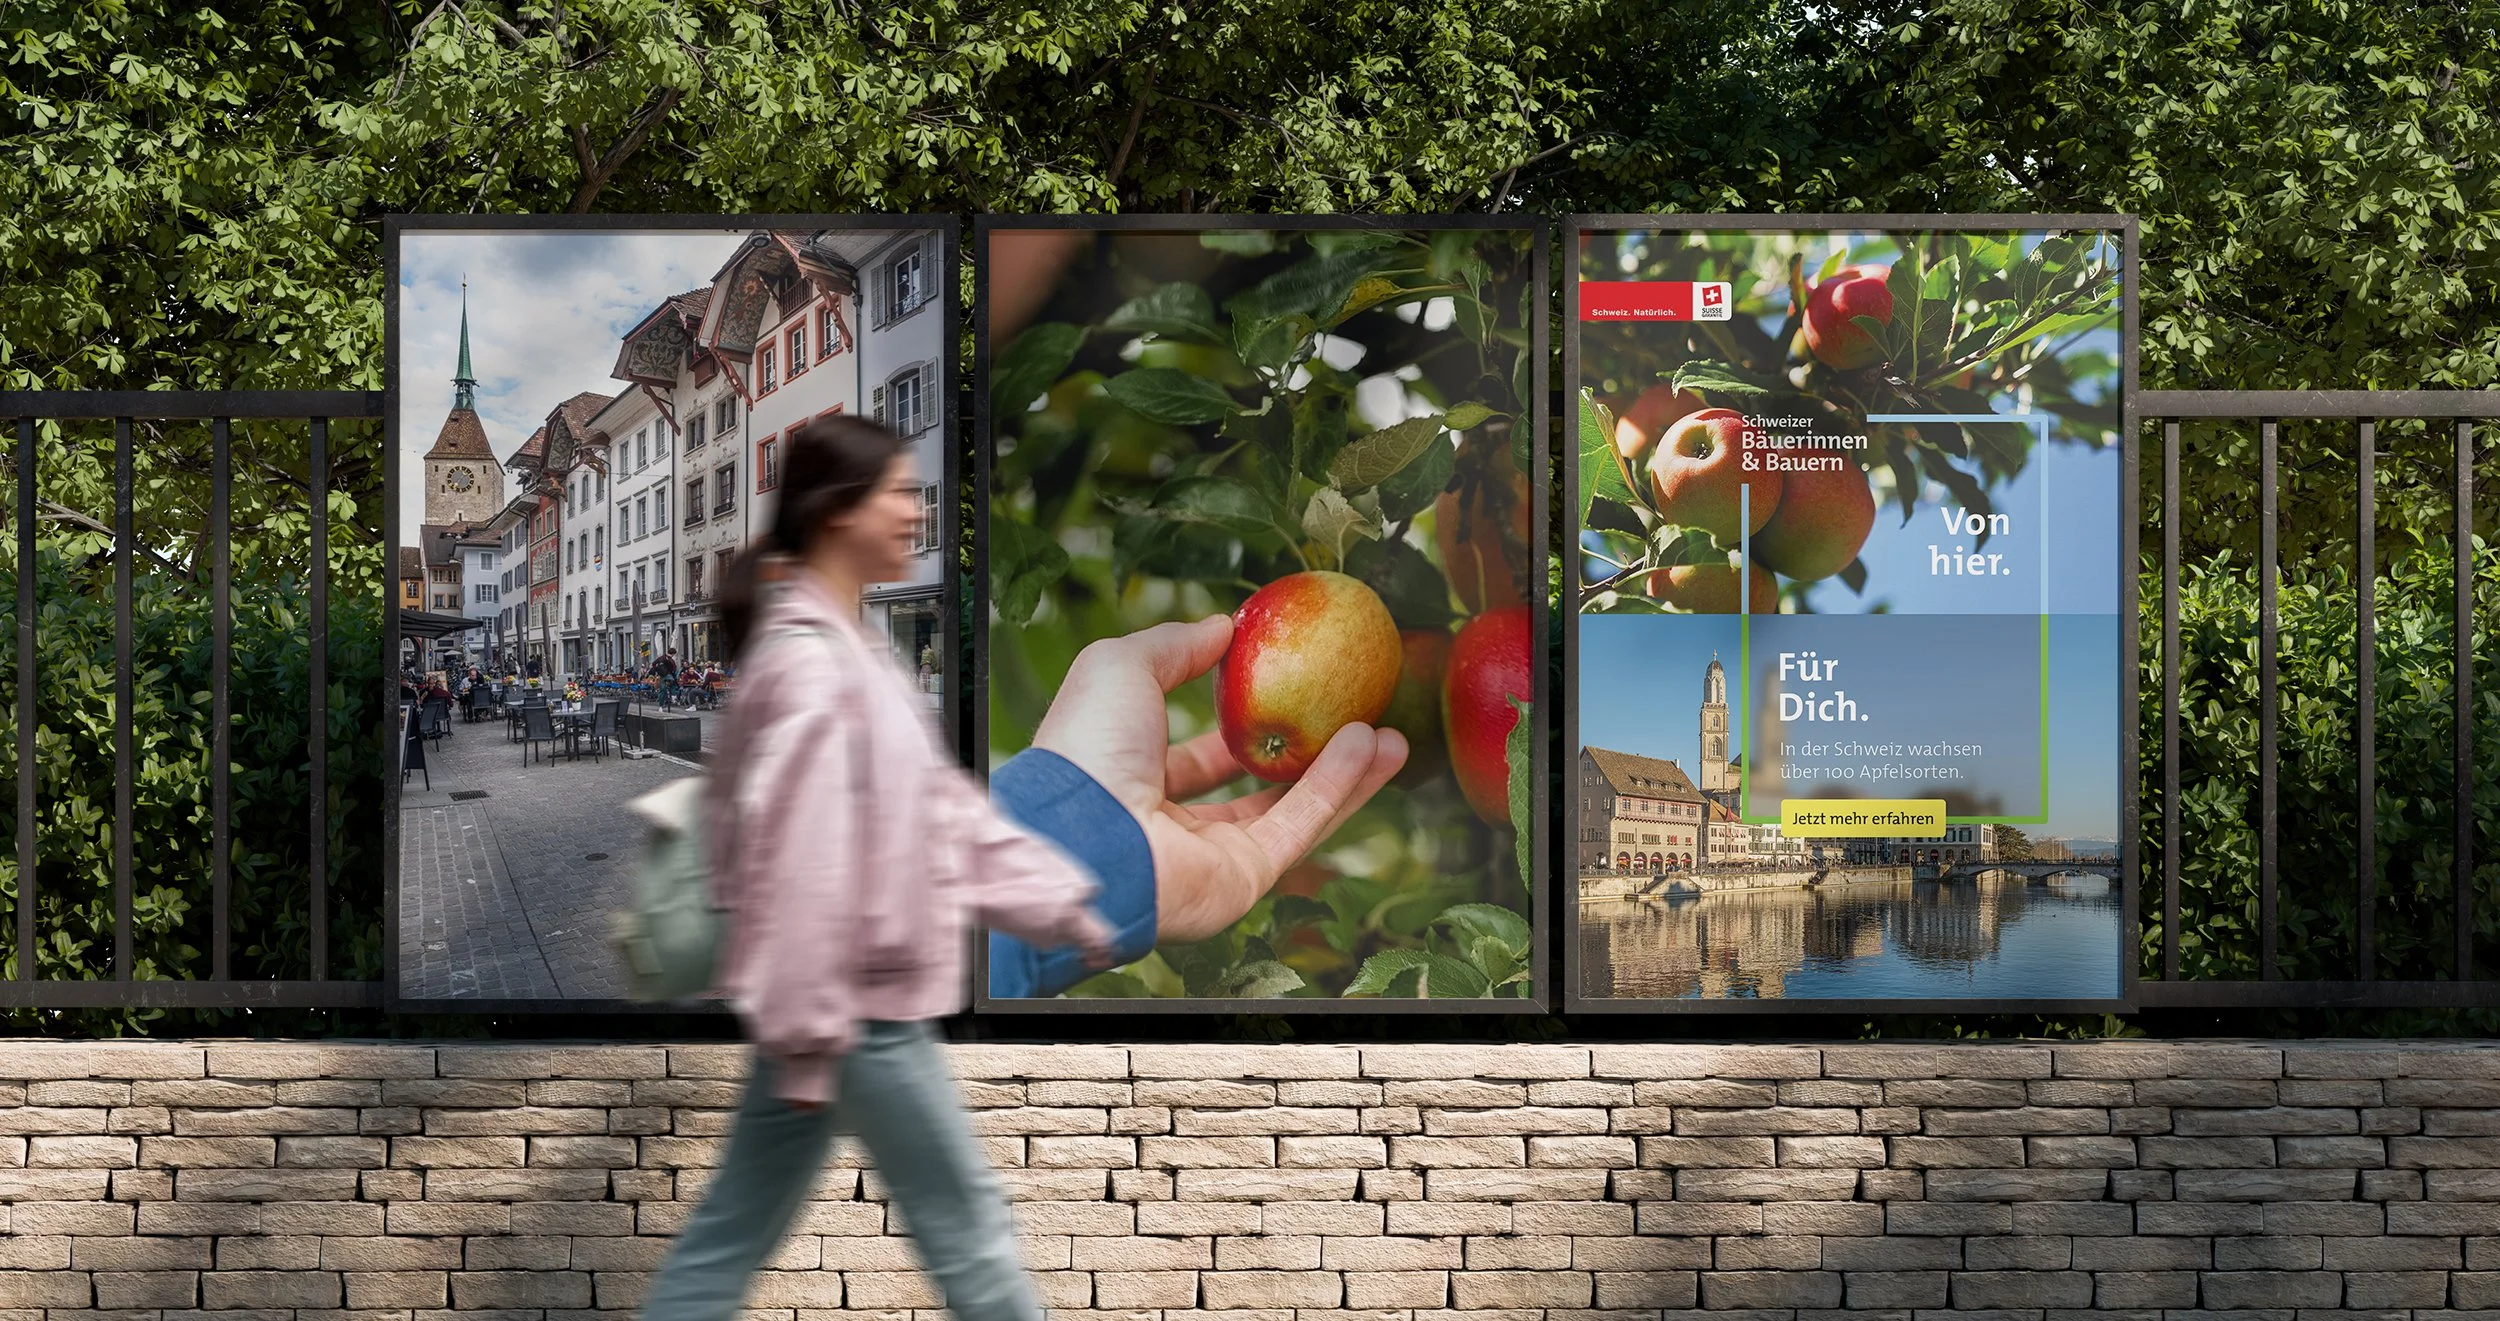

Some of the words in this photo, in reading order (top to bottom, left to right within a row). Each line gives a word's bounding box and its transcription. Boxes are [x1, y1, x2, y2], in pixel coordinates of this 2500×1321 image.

[1633, 308, 1676, 316] Natürlich.
[1741, 415, 1814, 427] Schweizer
[1741, 430, 1868, 449] Bäuerinnen
[1741, 452, 1760, 471] &
[1766, 453, 1843, 471] Bauern
[1941, 507, 2010, 536] Von
[1928, 545, 2011, 575] hier.
[1779, 651, 1839, 682] Für
[1779, 691, 1869, 722] Dich.
[1780, 742, 1796, 756] In
[1801, 740, 1829, 756] der
[1834, 741, 1903, 757] Schweiz
[1907, 740, 1982, 757] wachsen
[1780, 763, 1820, 780] über
[1824, 767, 1855, 780] 100
[1859, 763, 1964, 784] Apfelsorten.
[1792, 812, 1826, 825] Jetzt
[1830, 811, 1869, 825] mehr
[1871, 811, 1934, 825] erfahren
